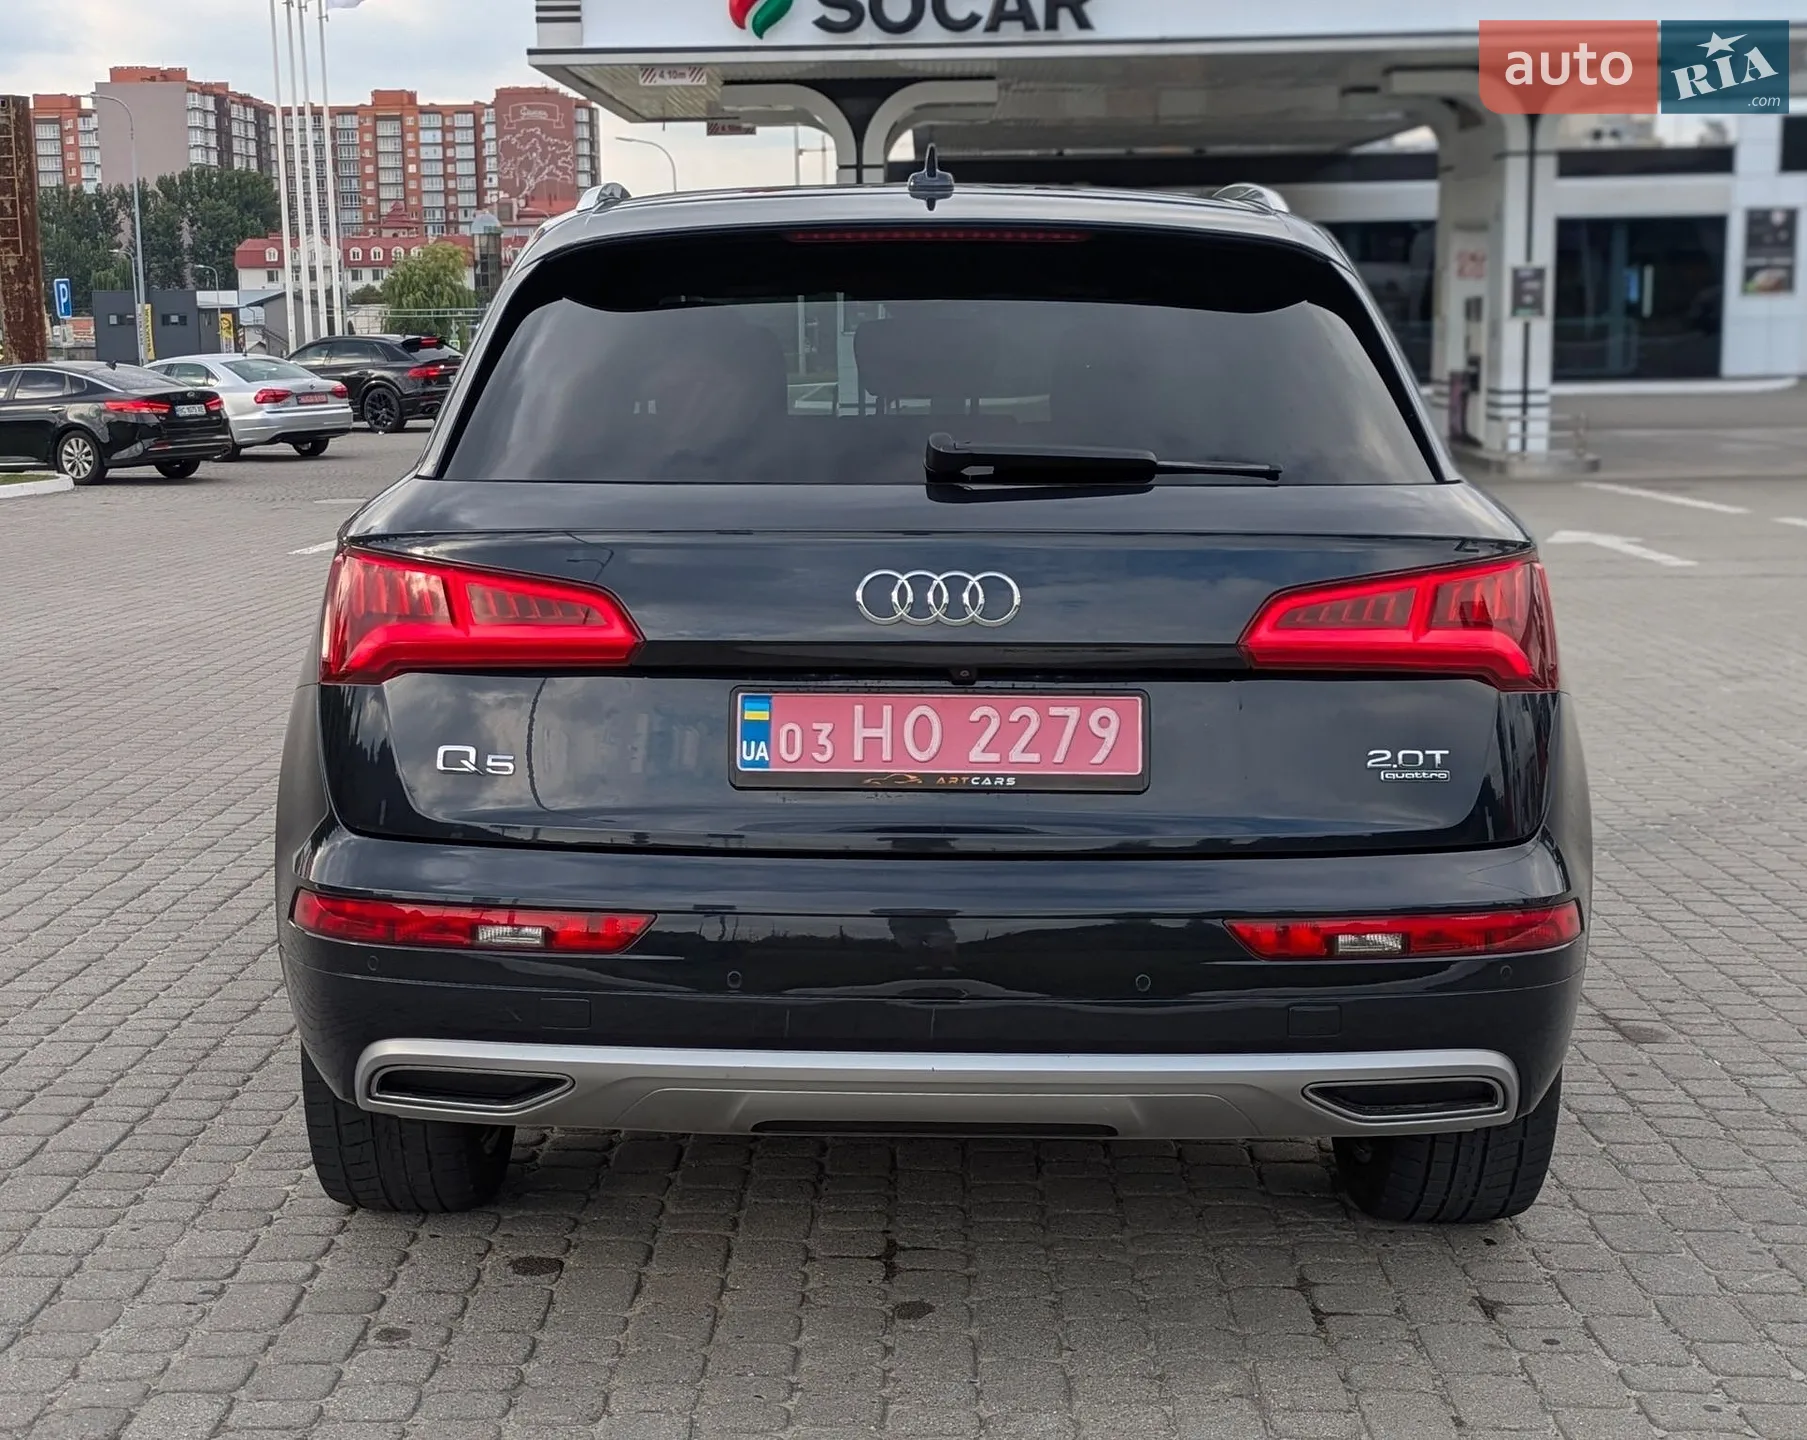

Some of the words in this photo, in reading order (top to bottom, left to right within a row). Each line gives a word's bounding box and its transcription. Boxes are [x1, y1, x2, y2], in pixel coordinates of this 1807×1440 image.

[812, 0, 1095, 34] SOCAR
[59, 283, 69, 313] P
[779, 722, 835, 763] 03
[853, 705, 943, 762] HO
[968, 706, 1121, 764] 2279
[436, 745, 515, 775] Q5
[742, 740, 770, 761] UA
[1366, 749, 1450, 768] 2.0T
[936, 776, 1016, 786] ARTCARS
[1384, 771, 1448, 780] quattro
